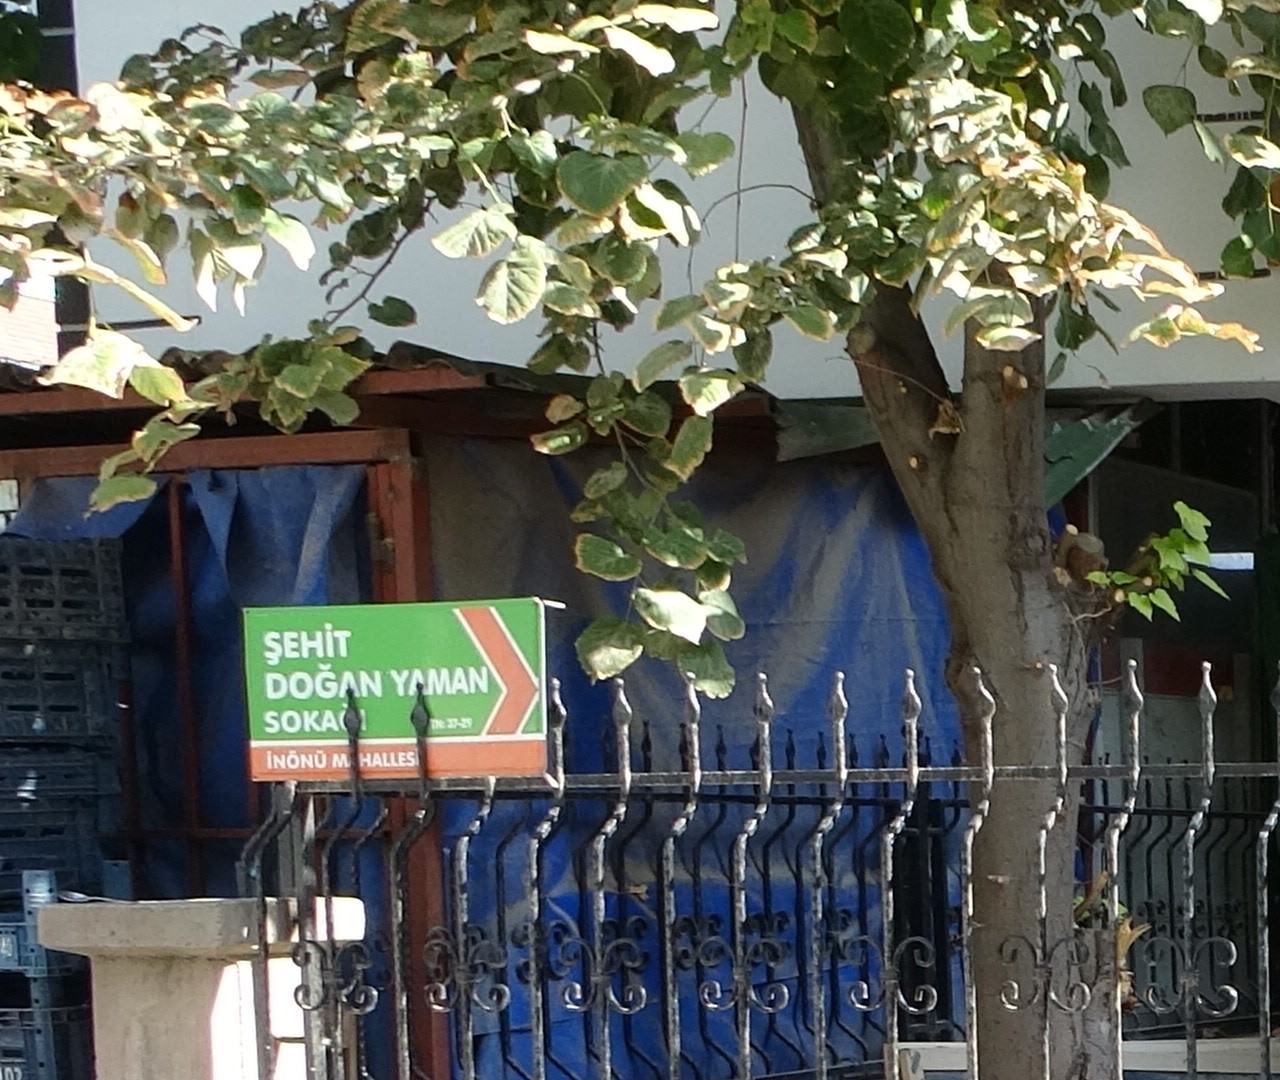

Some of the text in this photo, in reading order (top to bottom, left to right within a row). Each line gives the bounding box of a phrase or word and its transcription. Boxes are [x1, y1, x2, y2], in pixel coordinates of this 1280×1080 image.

[262, 623, 352, 666] ŞEHİT
[265, 664, 489, 701] DOĞAN YAMAN
[266, 749, 419, 770] İNÖNÜ MHALLESİ
